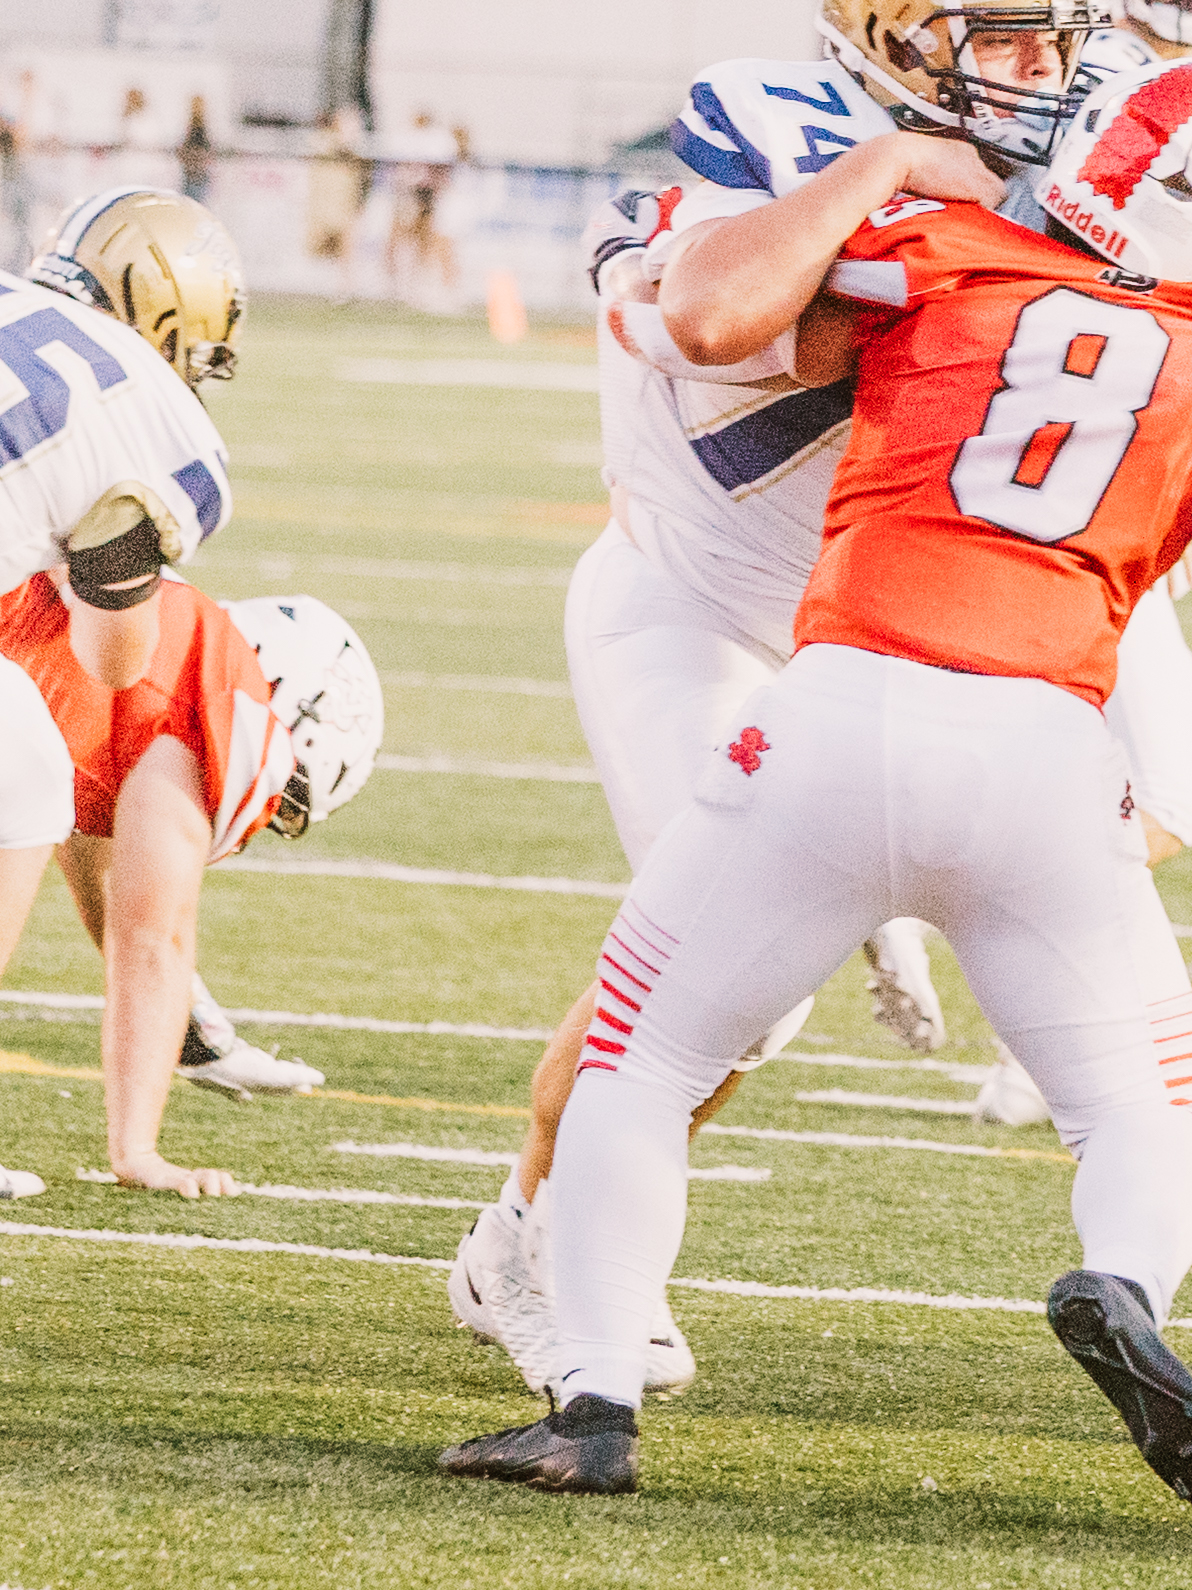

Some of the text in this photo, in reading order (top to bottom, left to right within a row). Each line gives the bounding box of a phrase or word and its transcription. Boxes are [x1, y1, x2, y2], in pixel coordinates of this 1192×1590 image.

[762, 80, 857, 174] 74
[1046, 184, 1128, 258] Riddell
[949, 284, 1173, 546] 8
